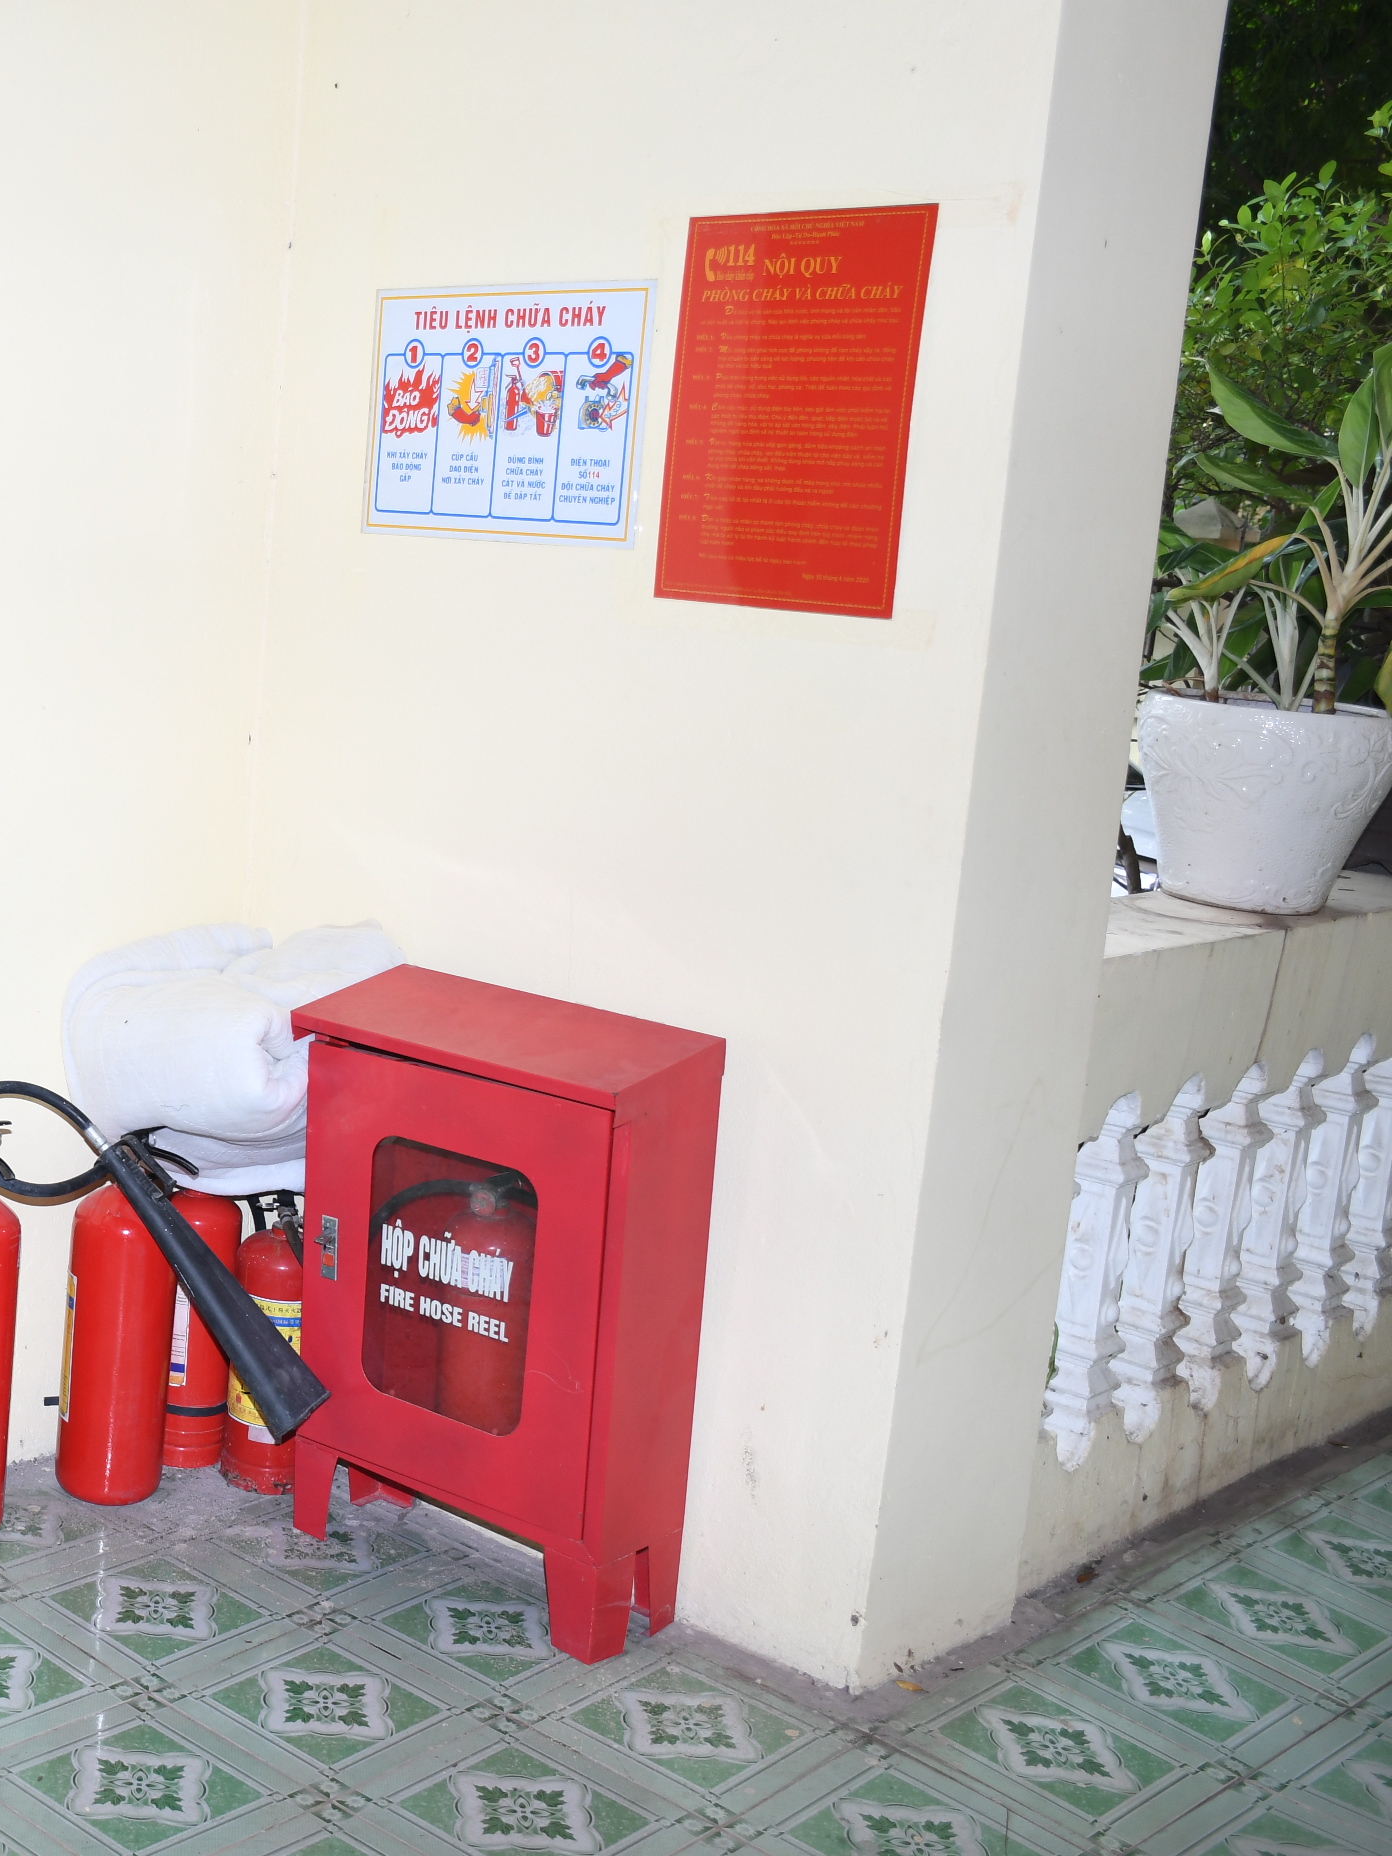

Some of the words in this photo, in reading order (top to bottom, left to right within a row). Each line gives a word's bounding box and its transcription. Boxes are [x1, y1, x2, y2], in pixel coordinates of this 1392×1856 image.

[727, 244, 756, 266] 114
[762, 253, 796, 278] NỘI
[800, 256, 842, 278] QUY
[701, 288, 749, 303] PHÒNG
[752, 285, 791, 302] CHÁY
[795, 284, 812, 301] VÀ
[814, 283, 858, 301] CHỮA
[860, 281, 903, 300] CHÁY
[415, 306, 449, 331] TIÊU
[455, 304, 497, 333] LỆNH
[504, 303, 551, 328] CHỮA
[559, 300, 606, 327] CHÁY
[409, 346, 418, 364] 1
[466, 343, 479, 362] 2
[527, 343, 540, 363] 3
[591, 343, 607, 362] 4
[392, 387, 420, 407] BÁO
[385, 408, 429, 436] ĐỘNG
[411, 450, 428, 460] CHÁY
[451, 452, 464, 462] CÚP
[507, 455, 526, 464] DÙNG
[528, 455, 544, 465] BÌNH
[589, 459, 610, 469] THOẠI
[449, 465, 462, 473] DAO
[505, 466, 524, 476] CHỮA
[525, 467, 544, 477] CHÁY
[467, 476, 485, 486] CHÁY
[501, 478, 515, 487] CÁT
[575, 482, 594, 492] CHỮA
[596, 482, 615, 493] CHÁY
[559, 493, 587, 504] CHUYÊN
[380, 1218, 415, 1278] HỘP
[418, 1231, 462, 1288] CHỮA
[468, 1248, 514, 1303] CHÁY
[380, 1283, 415, 1312] FIRE
[419, 1296, 463, 1328] HOSE
[467, 1311, 509, 1343] REEL
